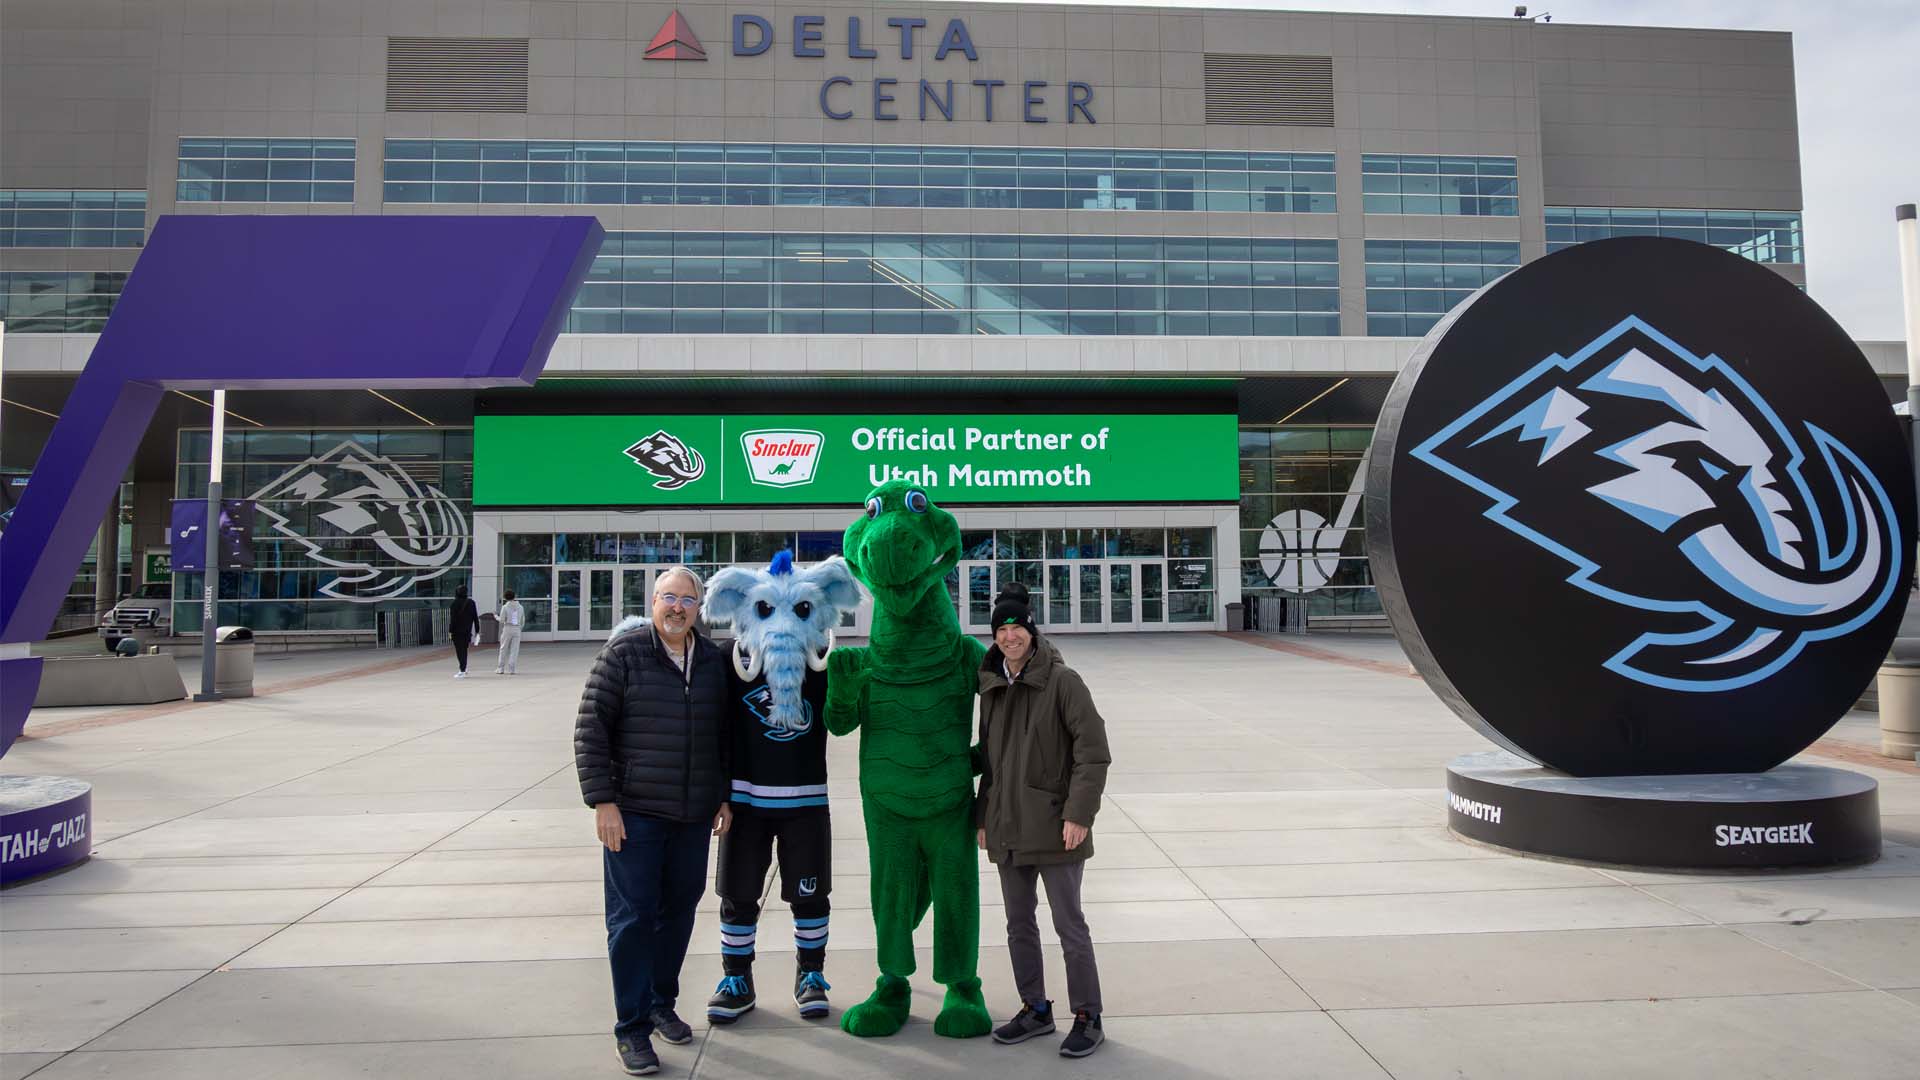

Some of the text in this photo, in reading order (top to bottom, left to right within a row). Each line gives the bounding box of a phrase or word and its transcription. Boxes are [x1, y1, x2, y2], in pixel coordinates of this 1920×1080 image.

[733, 14, 978, 60] DELTA
[820, 76, 1096, 124] CENTER
[752, 438, 815, 456] Sinclair
[851, 427, 1110, 451] Official Partner of
[869, 463, 1091, 487] Utah Mammoth
[1450, 791, 1502, 824] MAMMOTH
[0, 813, 86, 864] TAH JAZZ
[1715, 822, 1814, 847] SEATGEEK
